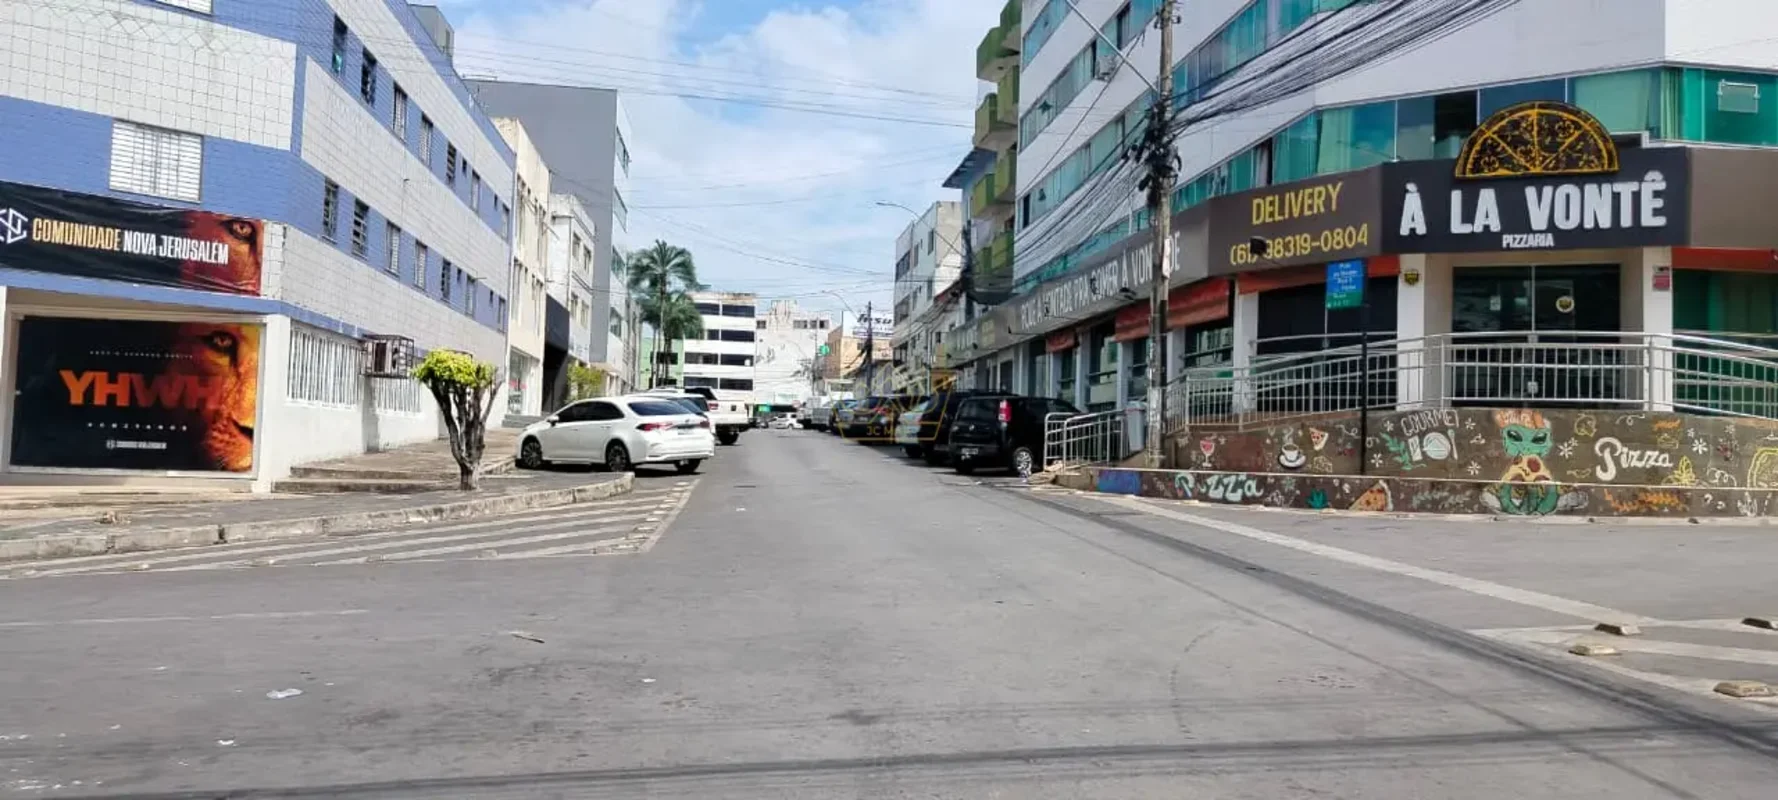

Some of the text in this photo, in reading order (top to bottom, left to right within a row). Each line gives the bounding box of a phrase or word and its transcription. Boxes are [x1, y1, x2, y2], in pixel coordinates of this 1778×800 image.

[1252, 181, 1343, 225] DELIVERY
[1399, 170, 1668, 236] À LA VONTÊ
[32, 217, 229, 265] COMUNIDADE NOVA JERUSALÉM
[1502, 232, 1555, 248] PIZZARIA
[59, 369, 223, 408] YHWH
[1594, 436, 1673, 481] Pizza
